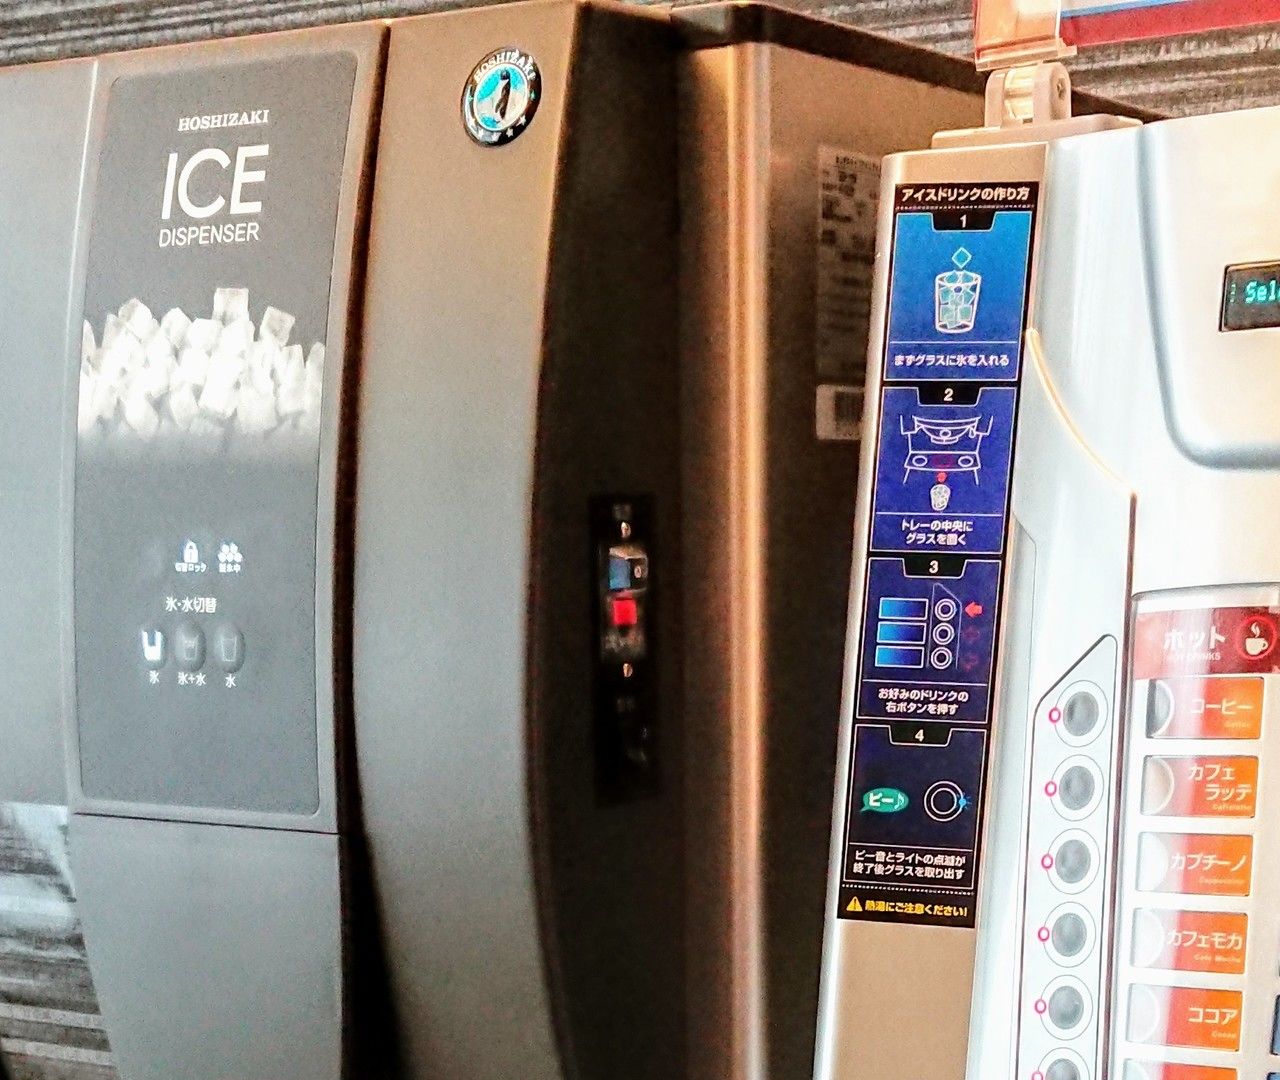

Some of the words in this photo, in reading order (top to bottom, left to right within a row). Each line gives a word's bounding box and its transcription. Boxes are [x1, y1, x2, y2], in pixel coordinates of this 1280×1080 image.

[177, 108, 270, 132] HOSHIZAKI
[161, 143, 270, 220] ICE
[901, 186, 1031, 202] アイスドリンクの作り方
[959, 214, 967, 229] 1
[158, 221, 261, 248] DISPENSER
[894, 354, 1010, 367] まずグラスに氷を入れる
[943, 388, 953, 401] 2
[901, 518, 974, 532] トレーの中央に
[929, 560, 939, 574] 3
[1163, 625, 1226, 651] ホット
[225, 673, 237, 689] 水
[877, 688, 969, 702] お好みのドリンクの
[885, 701, 959, 715] 右ボタンを押す
[1191, 698, 1255, 715] コーヒー
[915, 729, 925, 742] 4
[1187, 763, 1236, 781] カフェ
[1205, 783, 1253, 801] ラッテ
[852, 861, 965, 880] 終了後グラスを取り出す
[1166, 929, 1243, 951] カフェモカ
[1187, 1006, 1238, 1025] ココア
